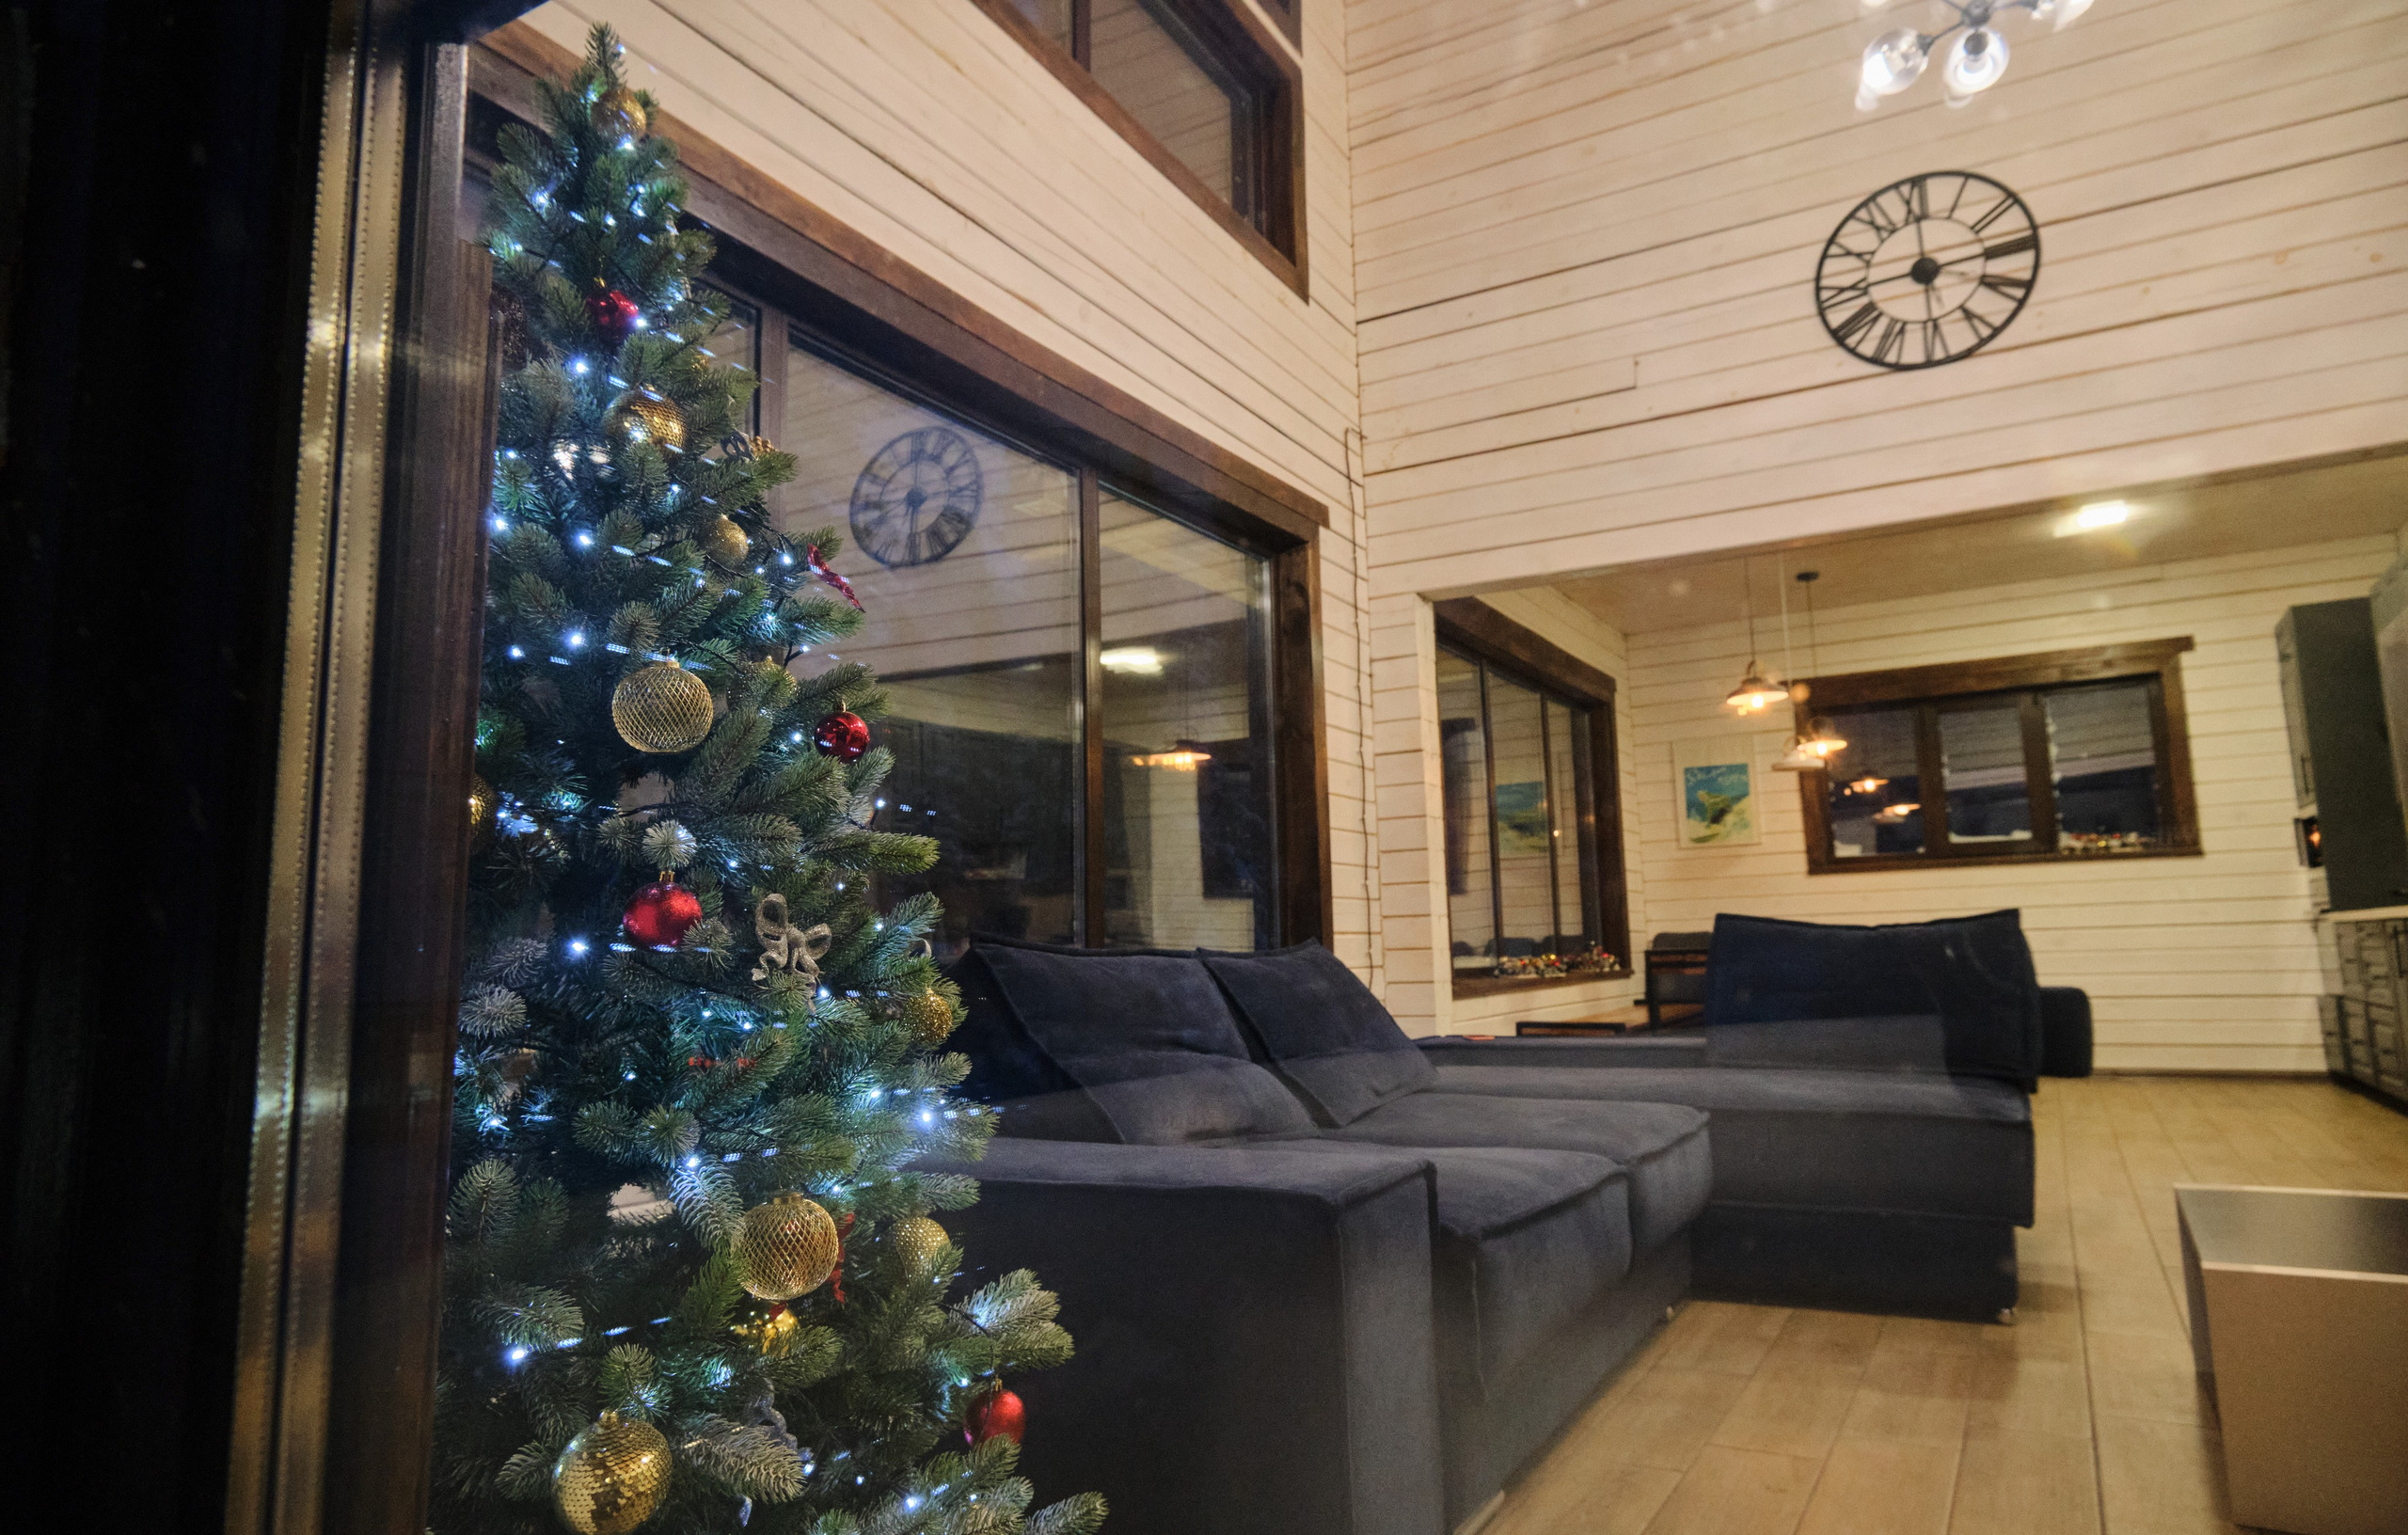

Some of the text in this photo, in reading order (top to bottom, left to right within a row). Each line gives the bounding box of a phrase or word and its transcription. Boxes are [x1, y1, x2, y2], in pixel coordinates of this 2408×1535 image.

[1849, 198, 1898, 243] XI
[1894, 178, 1929, 227] XII
[1970, 193, 2019, 234] II
[1825, 240, 1877, 265] X
[1818, 277, 1869, 311] IX
[1922, 319, 1951, 364] VI
[1959, 304, 2000, 342] V
